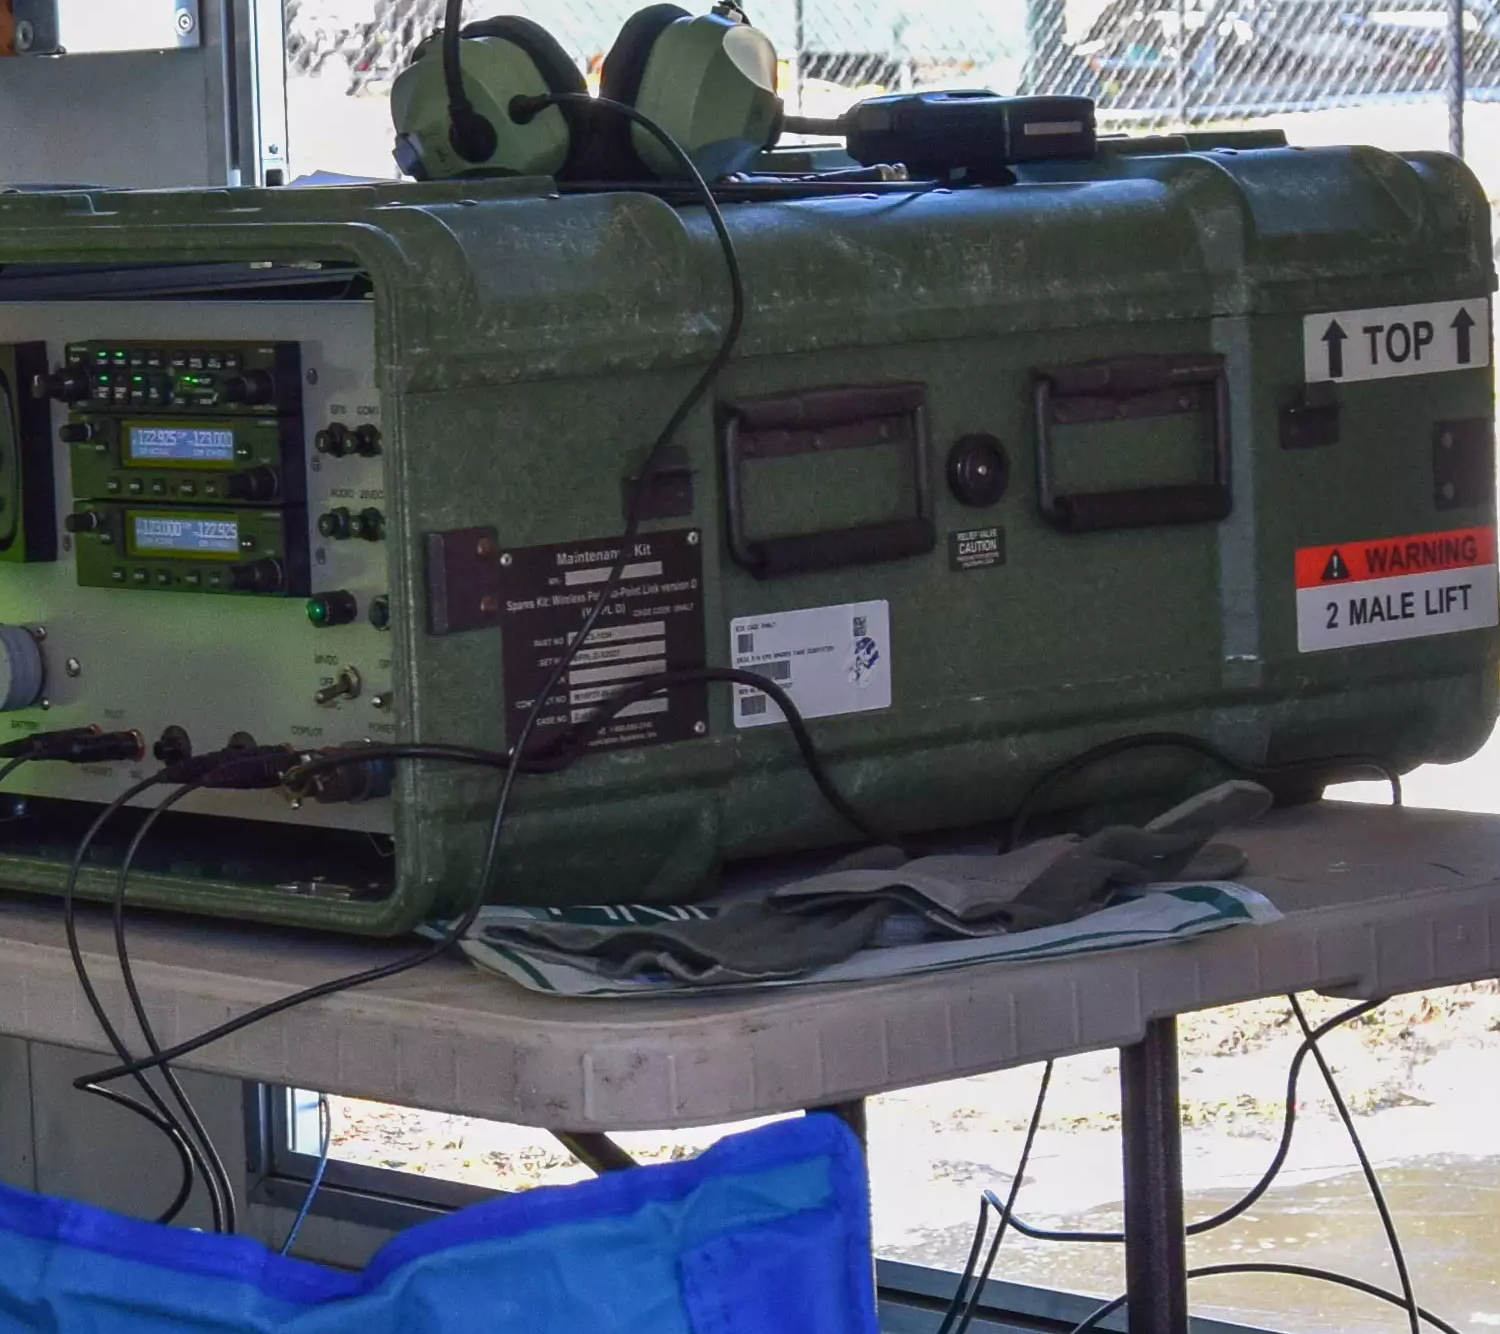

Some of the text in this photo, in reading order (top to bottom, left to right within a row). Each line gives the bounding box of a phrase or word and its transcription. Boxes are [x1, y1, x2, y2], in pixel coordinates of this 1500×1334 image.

[1362, 320, 1434, 365] TOP
[556, 544, 652, 566] Maintenan Kit
[959, 538, 997, 555] CAUTION
[1365, 535, 1478, 574] WARNING
[1326, 584, 1472, 630] 2 MALE LIFT
